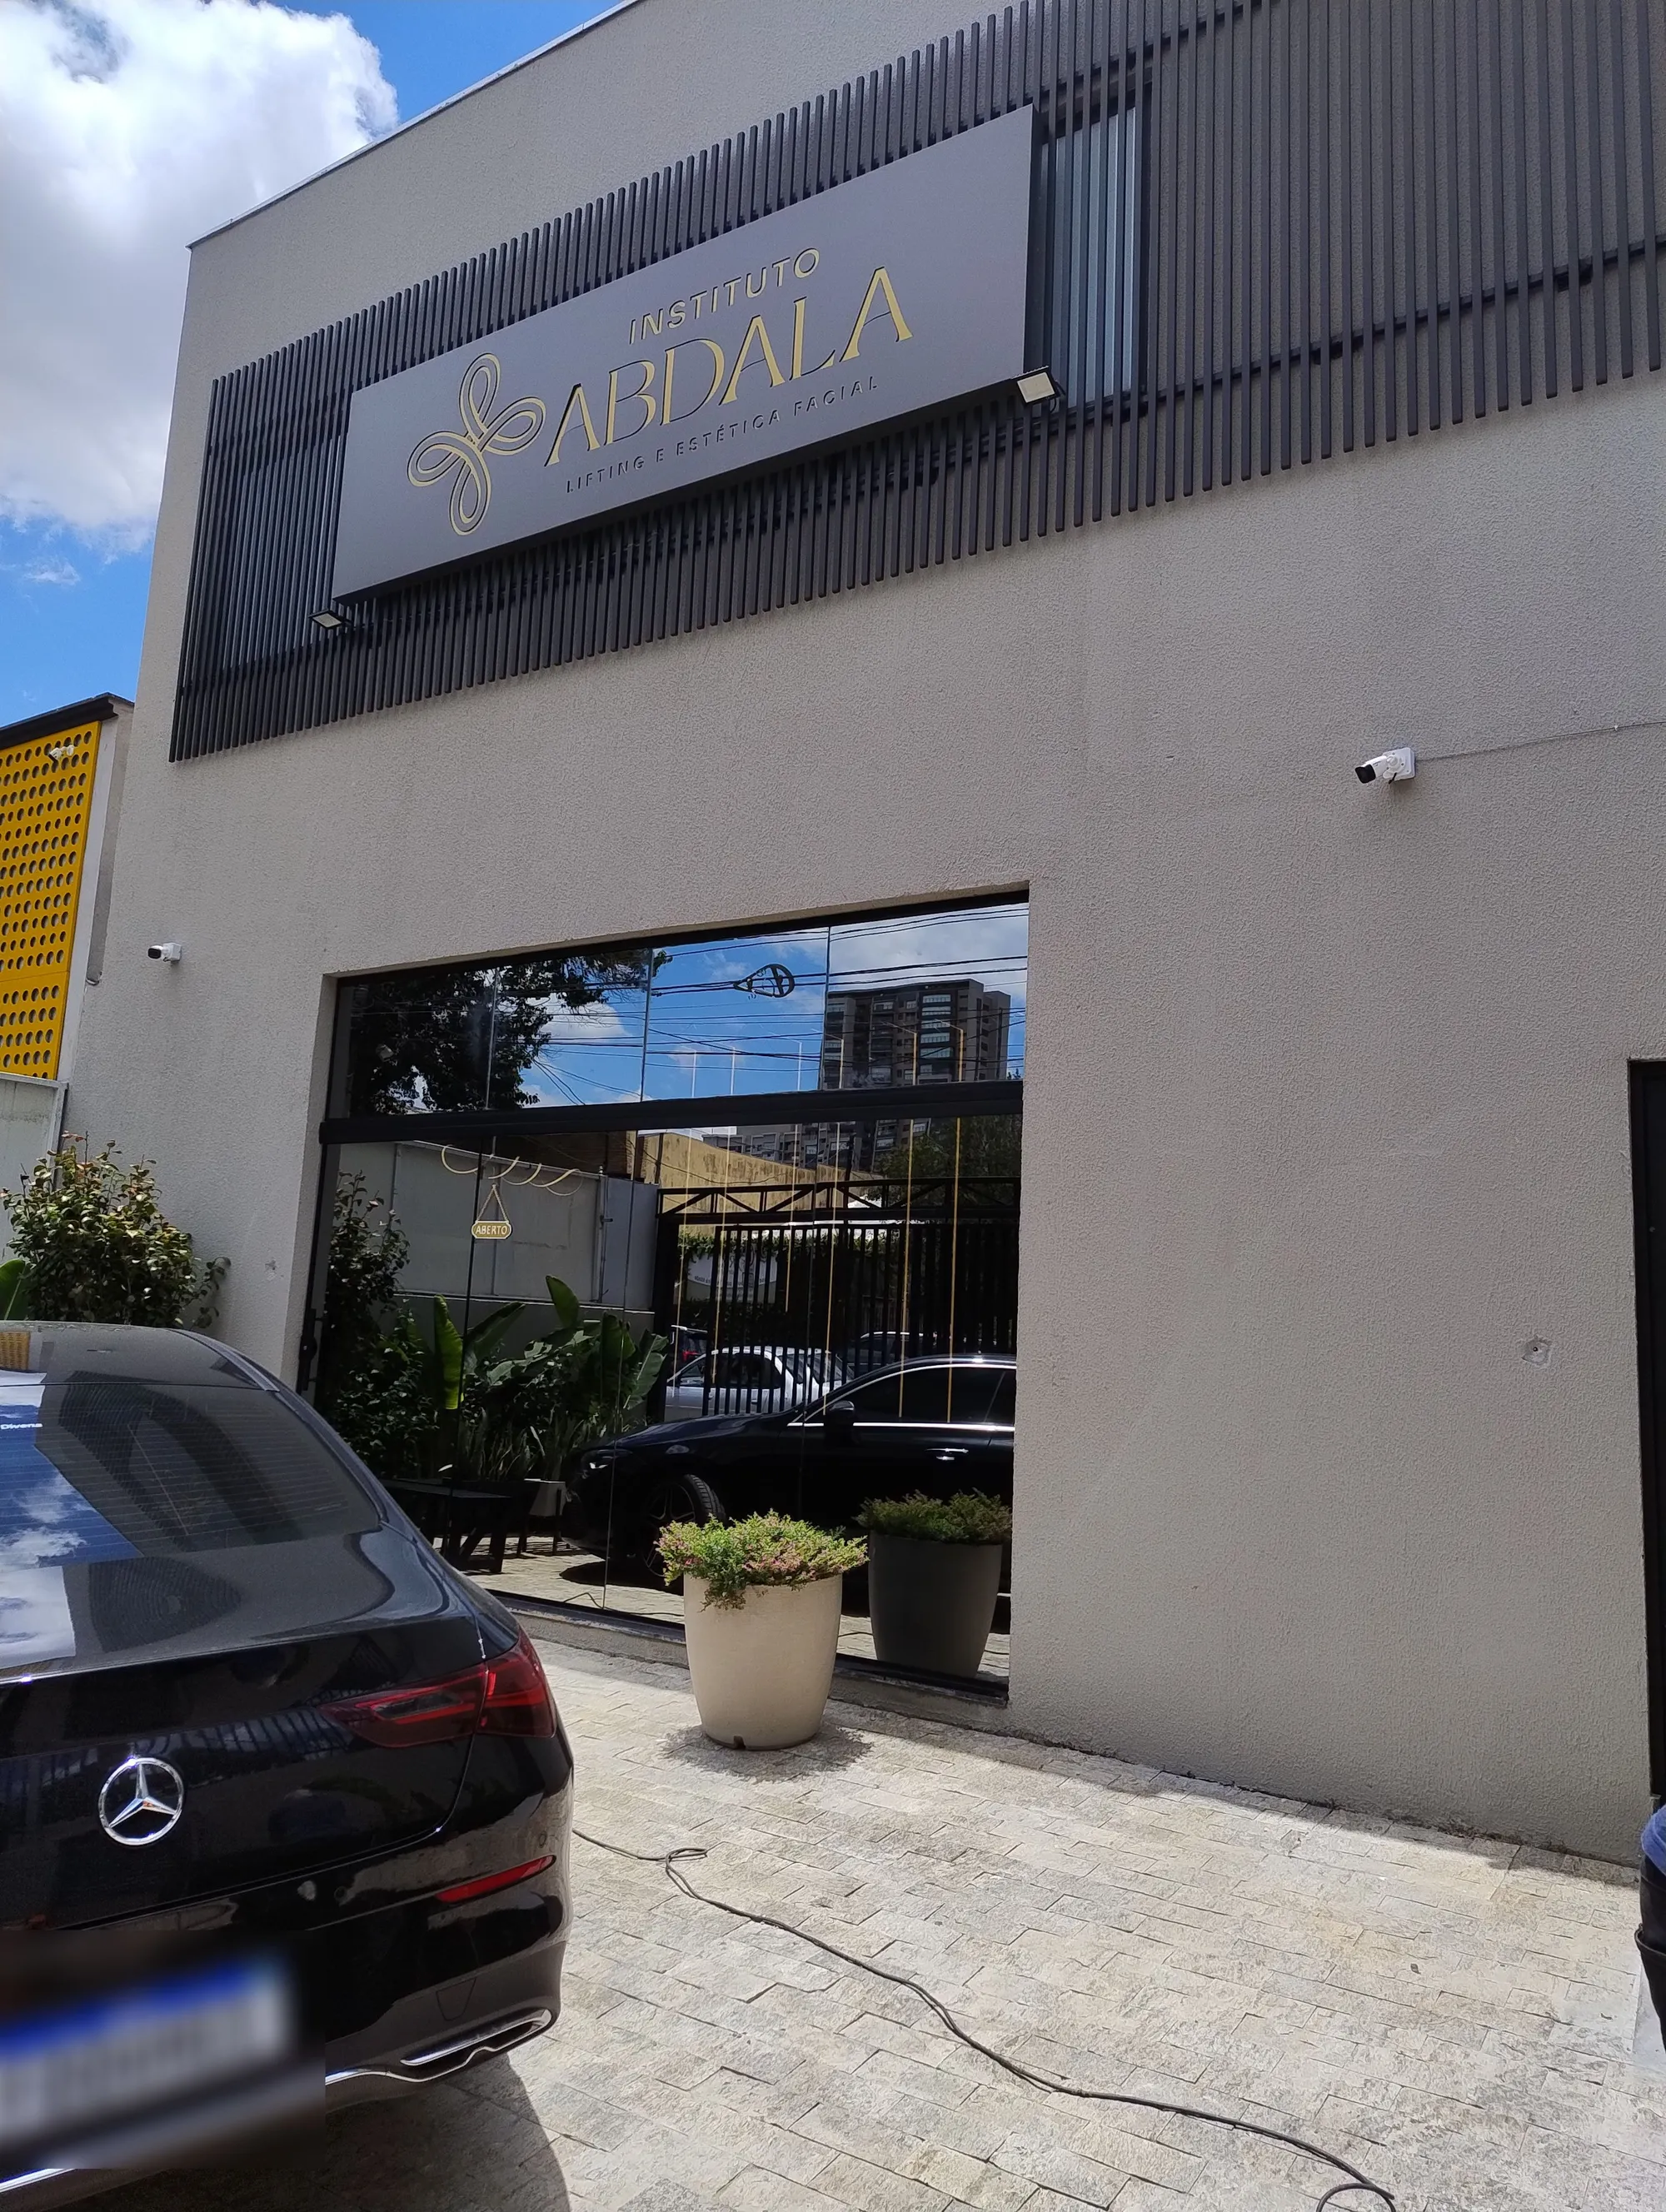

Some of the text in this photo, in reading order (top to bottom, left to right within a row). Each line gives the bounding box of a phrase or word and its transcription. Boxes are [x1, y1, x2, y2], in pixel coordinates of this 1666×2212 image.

[630, 247, 820, 345] INSTITUTO
[545, 267, 914, 467] ABDALA
[566, 376, 878, 493] LIFTING E ESTÉTICA FACIAL
[475, 1225, 508, 1235] ABERTO
